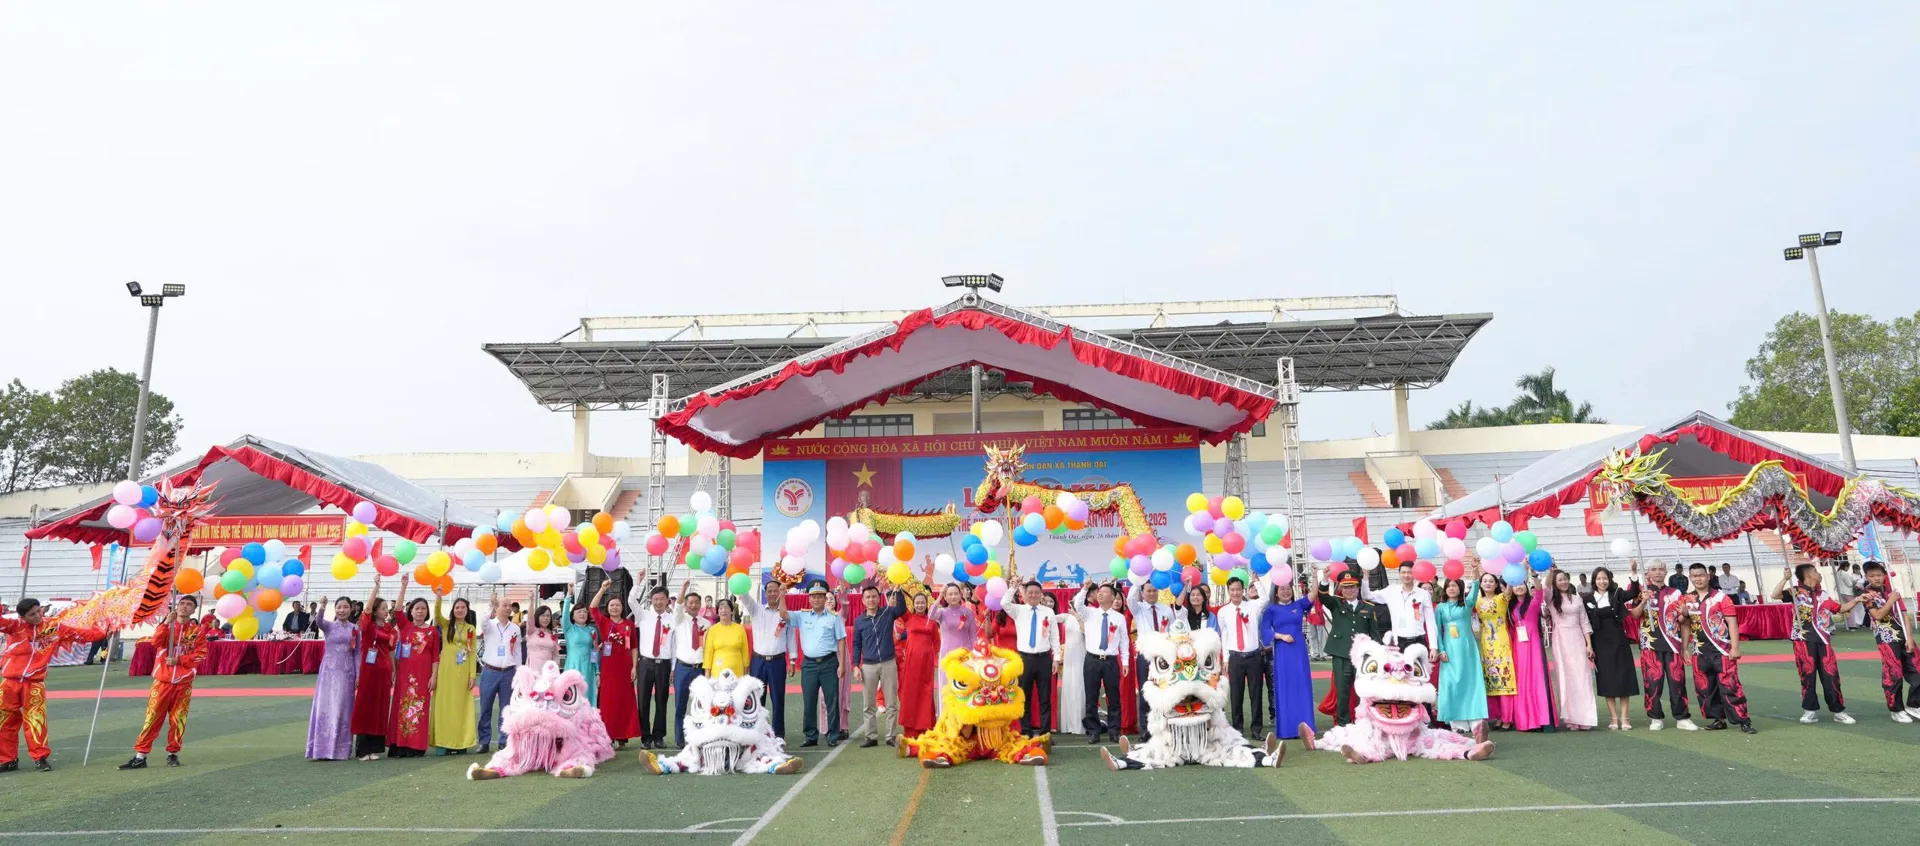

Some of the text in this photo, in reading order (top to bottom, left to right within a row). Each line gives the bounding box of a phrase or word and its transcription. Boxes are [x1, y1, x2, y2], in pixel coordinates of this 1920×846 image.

[797, 442, 830, 455] NƯỚC
[833, 441, 868, 457] CỘNG
[871, 441, 898, 453] HÒA
[902, 440, 920, 452] XÃ
[923, 439, 947, 455] HỘI
[950, 437, 976, 451] CHỦ
[1024, 435, 1055, 450] VIỆT
[1058, 437, 1087, 447] NAM
[1090, 433, 1128, 446] MUÔN
[1132, 433, 1161, 445] NĂM
[1068, 461, 1092, 469] THANH
[1094, 461, 1107, 469] OAI
[1148, 512, 1168, 526] 2025
[263, 524, 279, 539] THANH
